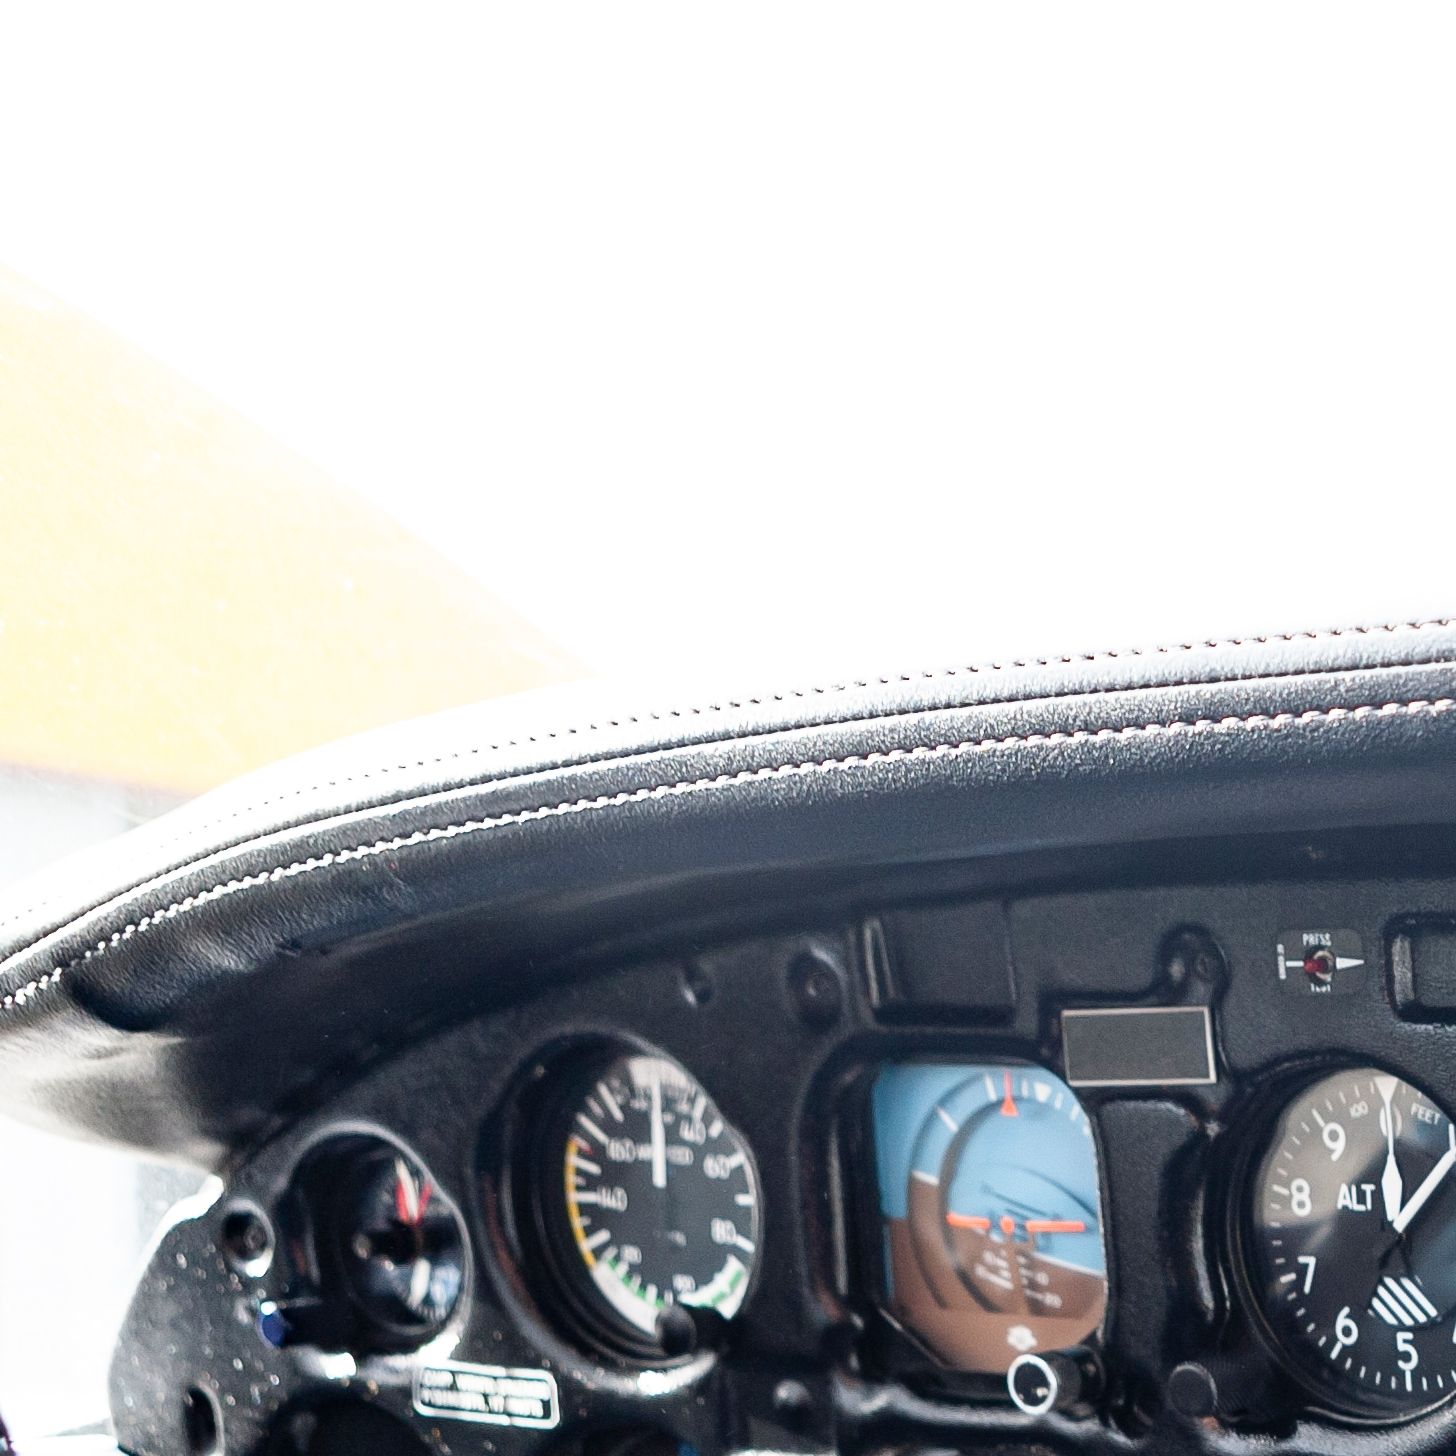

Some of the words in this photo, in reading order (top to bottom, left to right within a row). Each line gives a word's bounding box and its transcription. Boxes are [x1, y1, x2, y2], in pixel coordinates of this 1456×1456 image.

[1410, 1101, 1441, 1125] FEET
[1322, 1121, 1346, 1162] 9
[704, 1154, 731, 1180] 60
[1290, 1178, 1312, 1217] 8
[1337, 1183, 1376, 1212] ALT
[1298, 1255, 1317, 1295] 7
[1335, 1304, 1359, 1345] 6
[1396, 1331, 1419, 1371] 5
